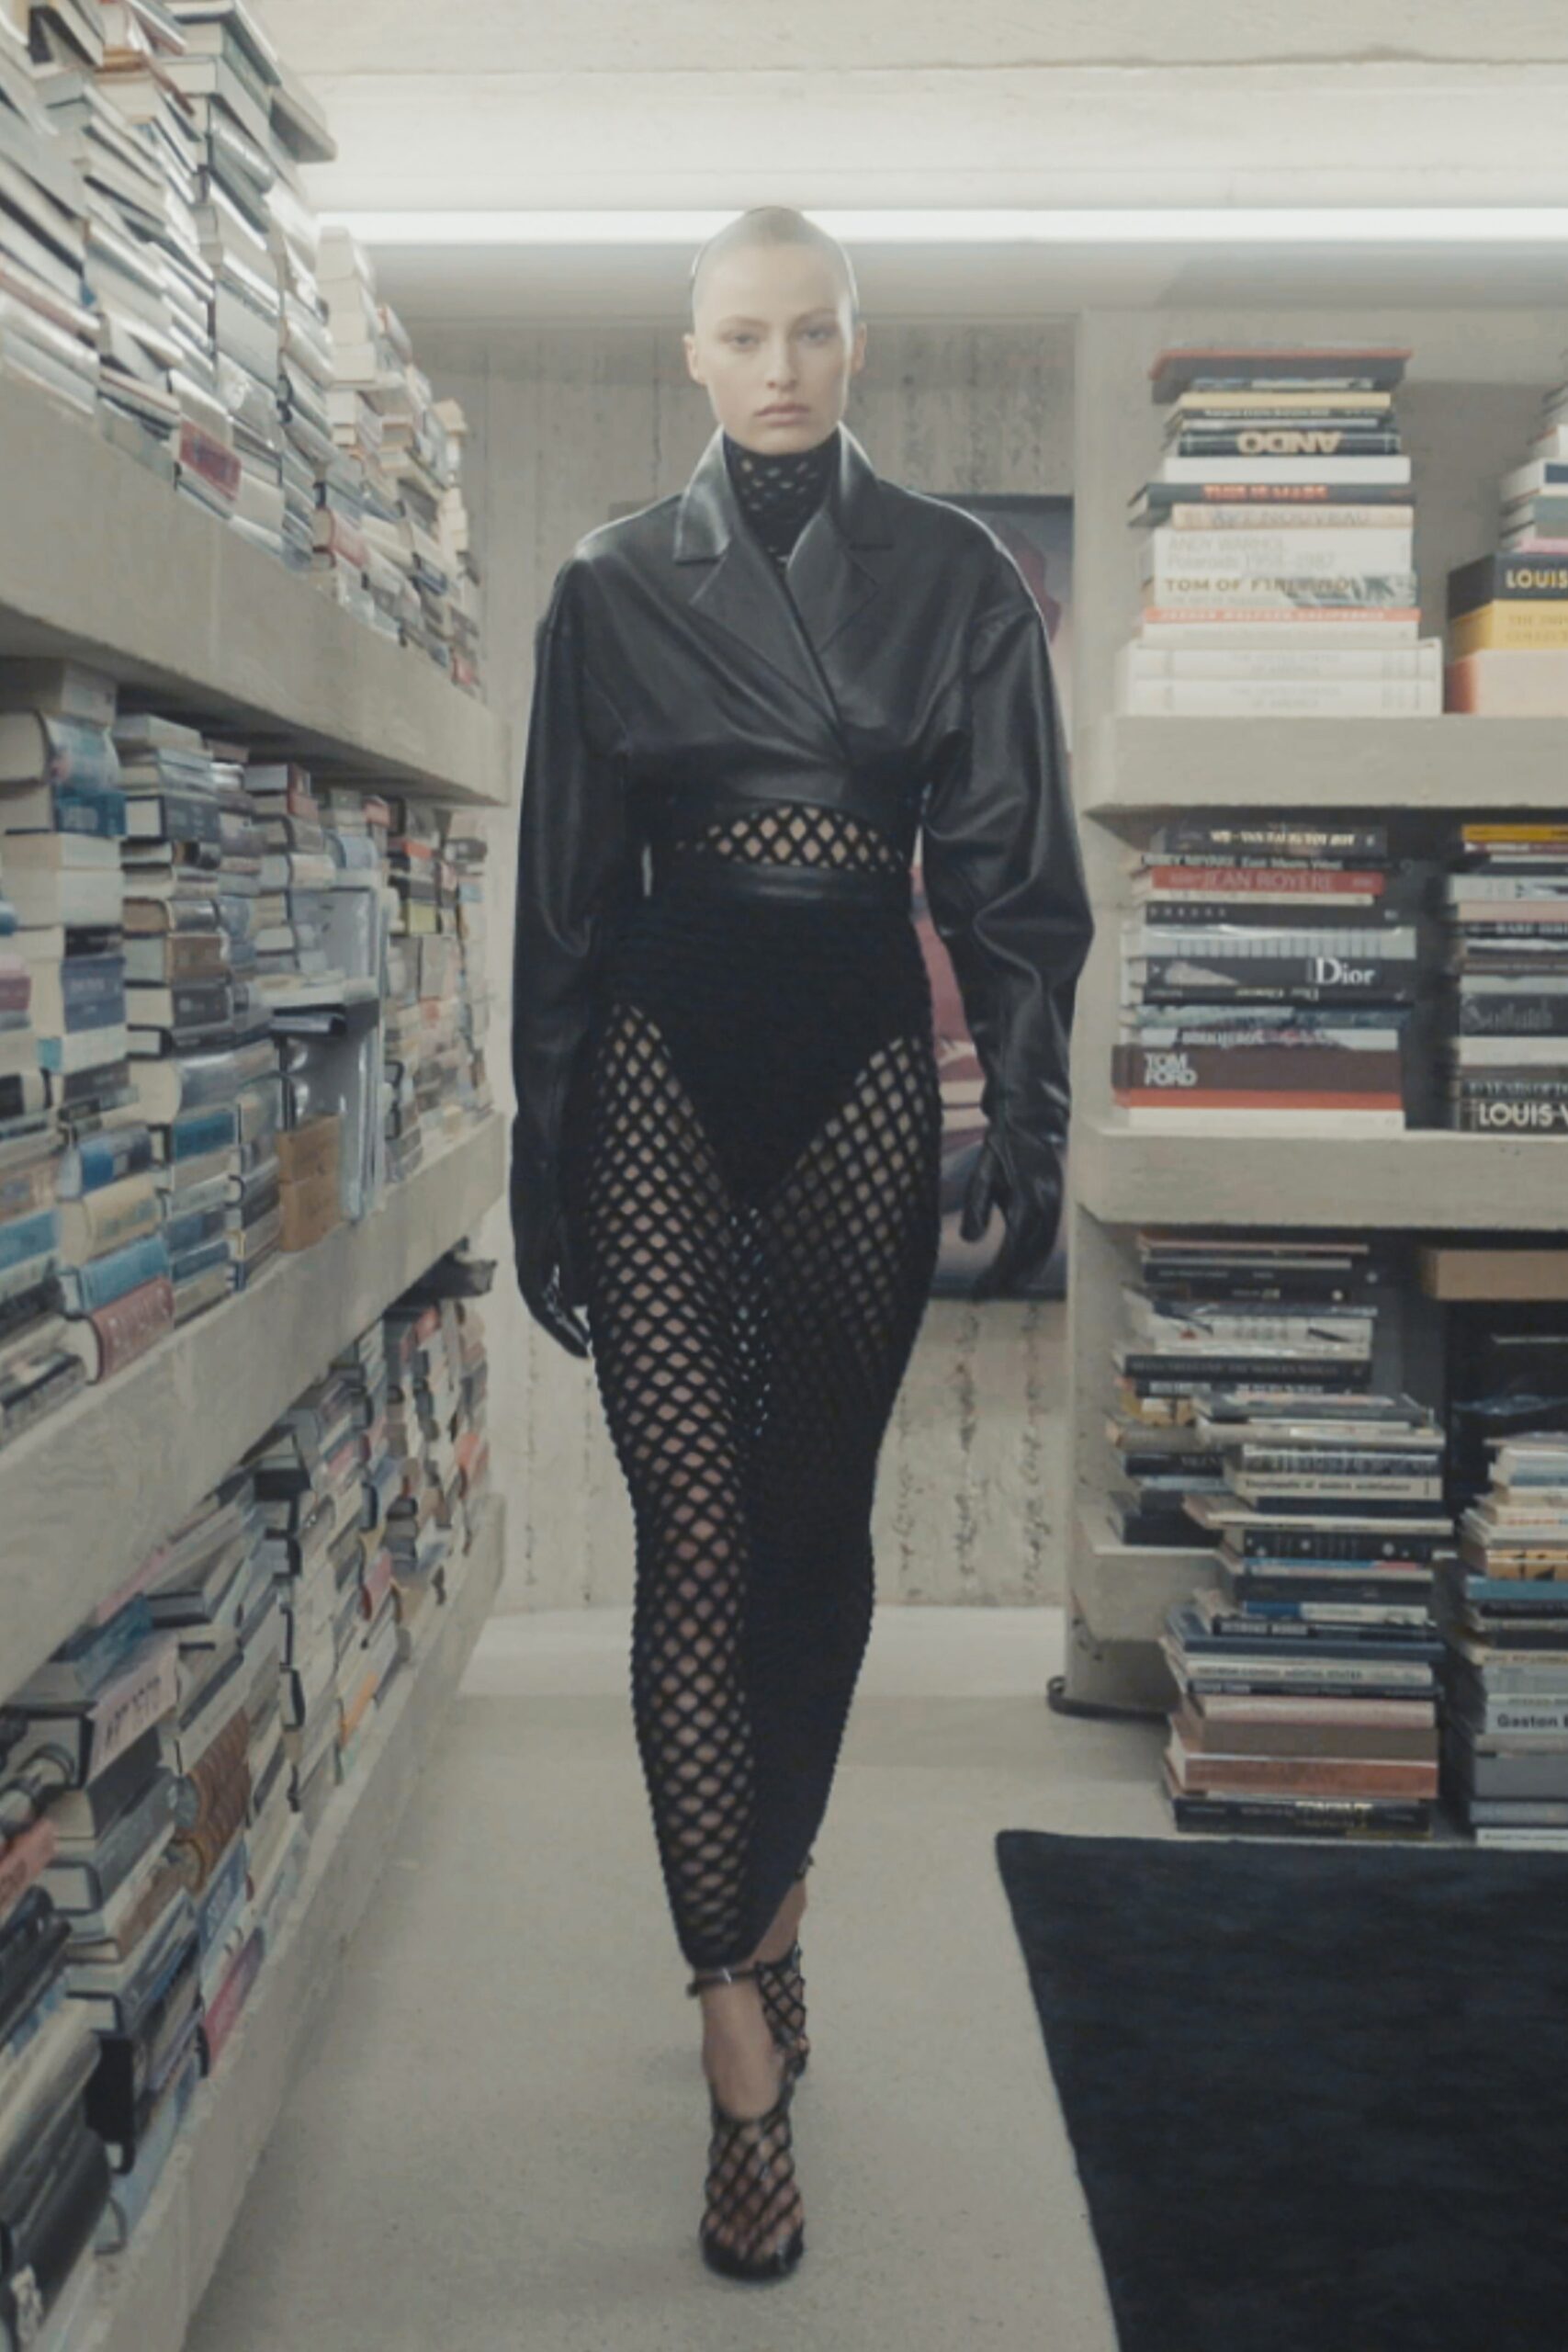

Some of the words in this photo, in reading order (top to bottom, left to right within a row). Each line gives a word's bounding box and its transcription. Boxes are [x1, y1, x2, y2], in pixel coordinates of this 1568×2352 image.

[1236, 431, 1343, 453] ANDO
[1166, 578, 1210, 592] TOM
[1214, 578, 1241, 592] OF
[1314, 957, 1376, 985] Dior
[1144, 1053, 1188, 1069] TOM
[1144, 1069, 1198, 1087] FORD
[1479, 1103, 1555, 1126] LOUIS
[1496, 1713, 1559, 1728] Gaston
